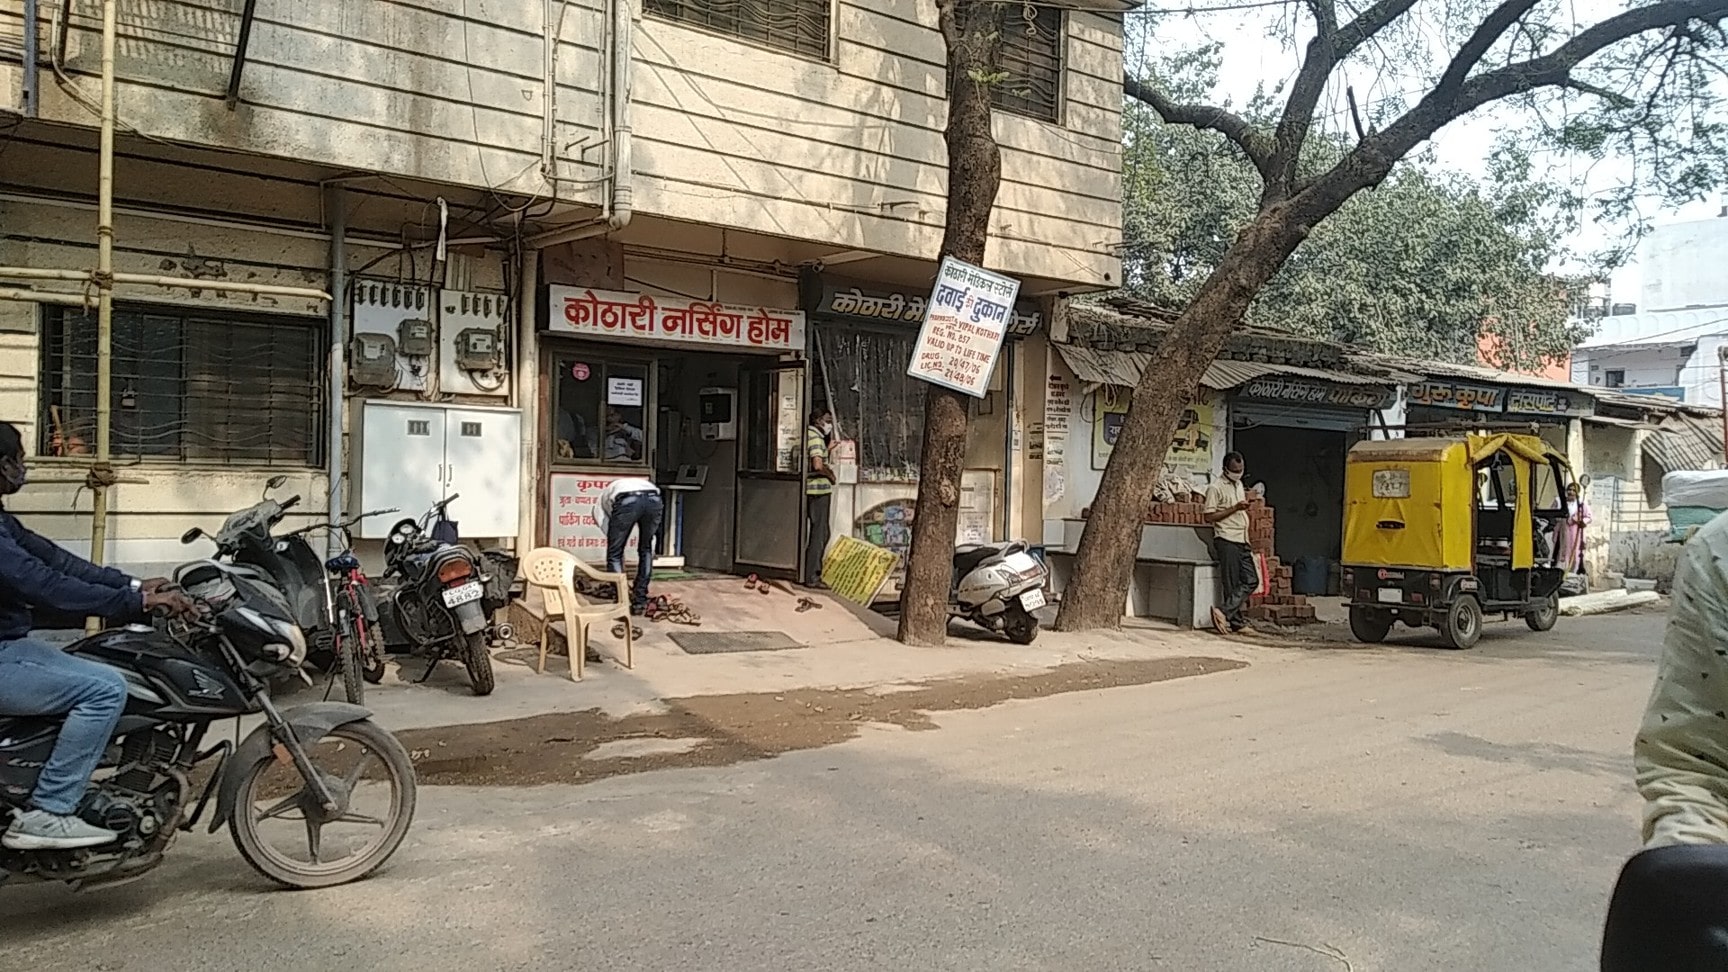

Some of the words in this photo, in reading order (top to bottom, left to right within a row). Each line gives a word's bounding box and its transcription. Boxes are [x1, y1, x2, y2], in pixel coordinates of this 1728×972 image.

[944, 263, 968, 283] कोठारी
[564, 289, 658, 332] कोठारी
[661, 302, 744, 339] नर्सिंग
[746, 307, 792, 344] होम
[831, 287, 906, 320] कोठारी
[935, 283, 971, 312] दवाई
[970, 297, 1008, 323] दुकान
[958, 321, 975, 334] VIPAL
[926, 336, 945, 349] VALID
[963, 348, 976, 359] LIFE
[976, 352, 991, 364] TIME
